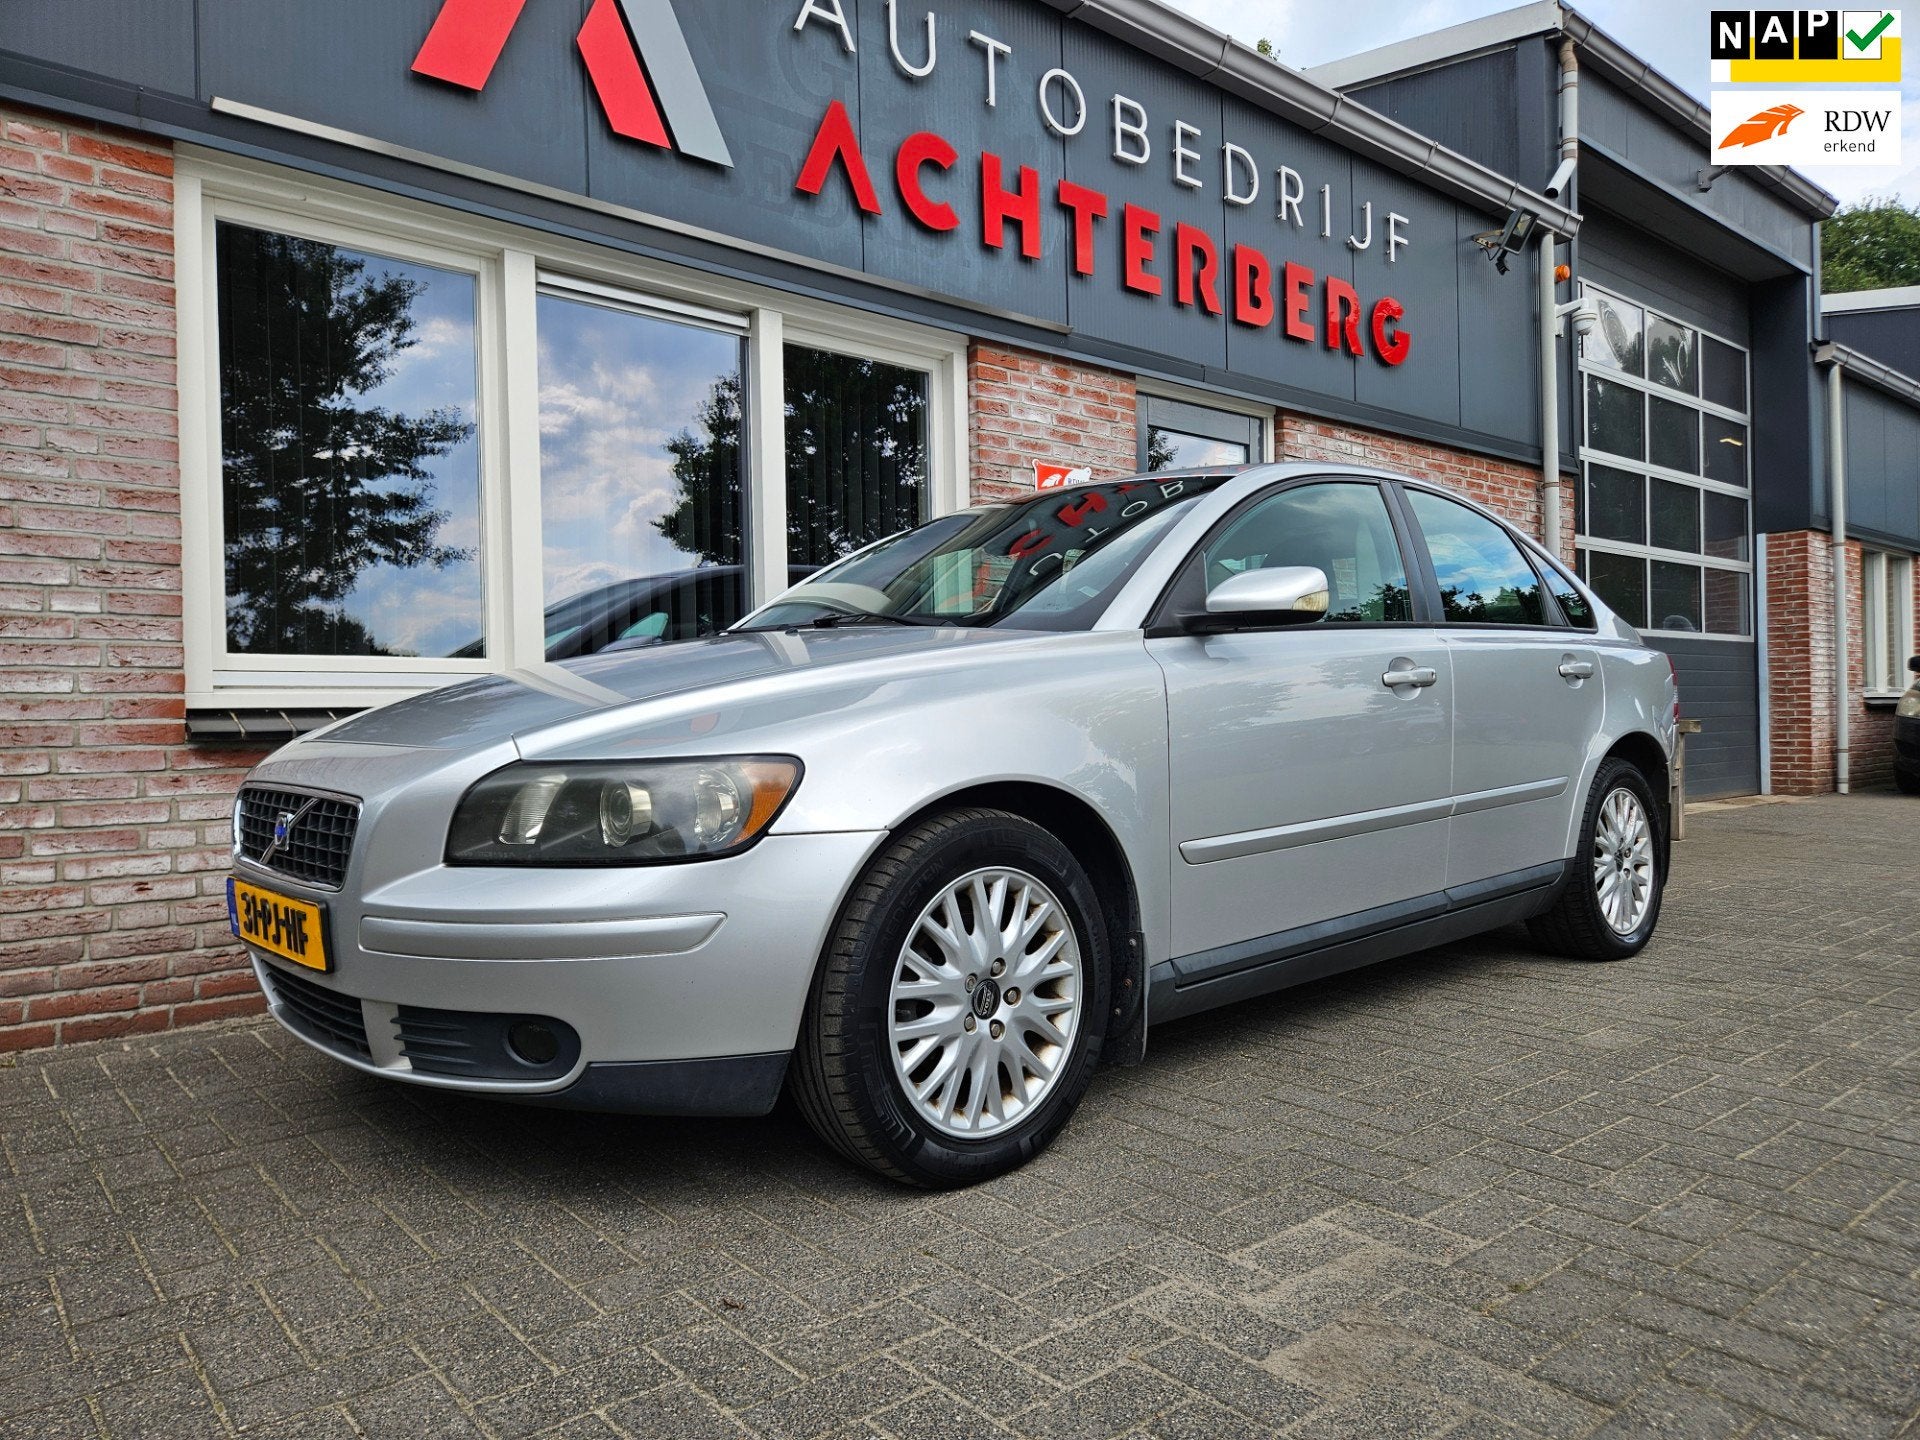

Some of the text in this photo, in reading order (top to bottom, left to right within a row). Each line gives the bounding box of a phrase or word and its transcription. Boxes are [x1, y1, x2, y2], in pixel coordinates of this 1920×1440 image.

[793, 0, 1410, 262] AUTOBEDRIJF
[795, 99, 1412, 366] ACHTERBERG
[240, 891, 309, 956] 31-PJ-HF
